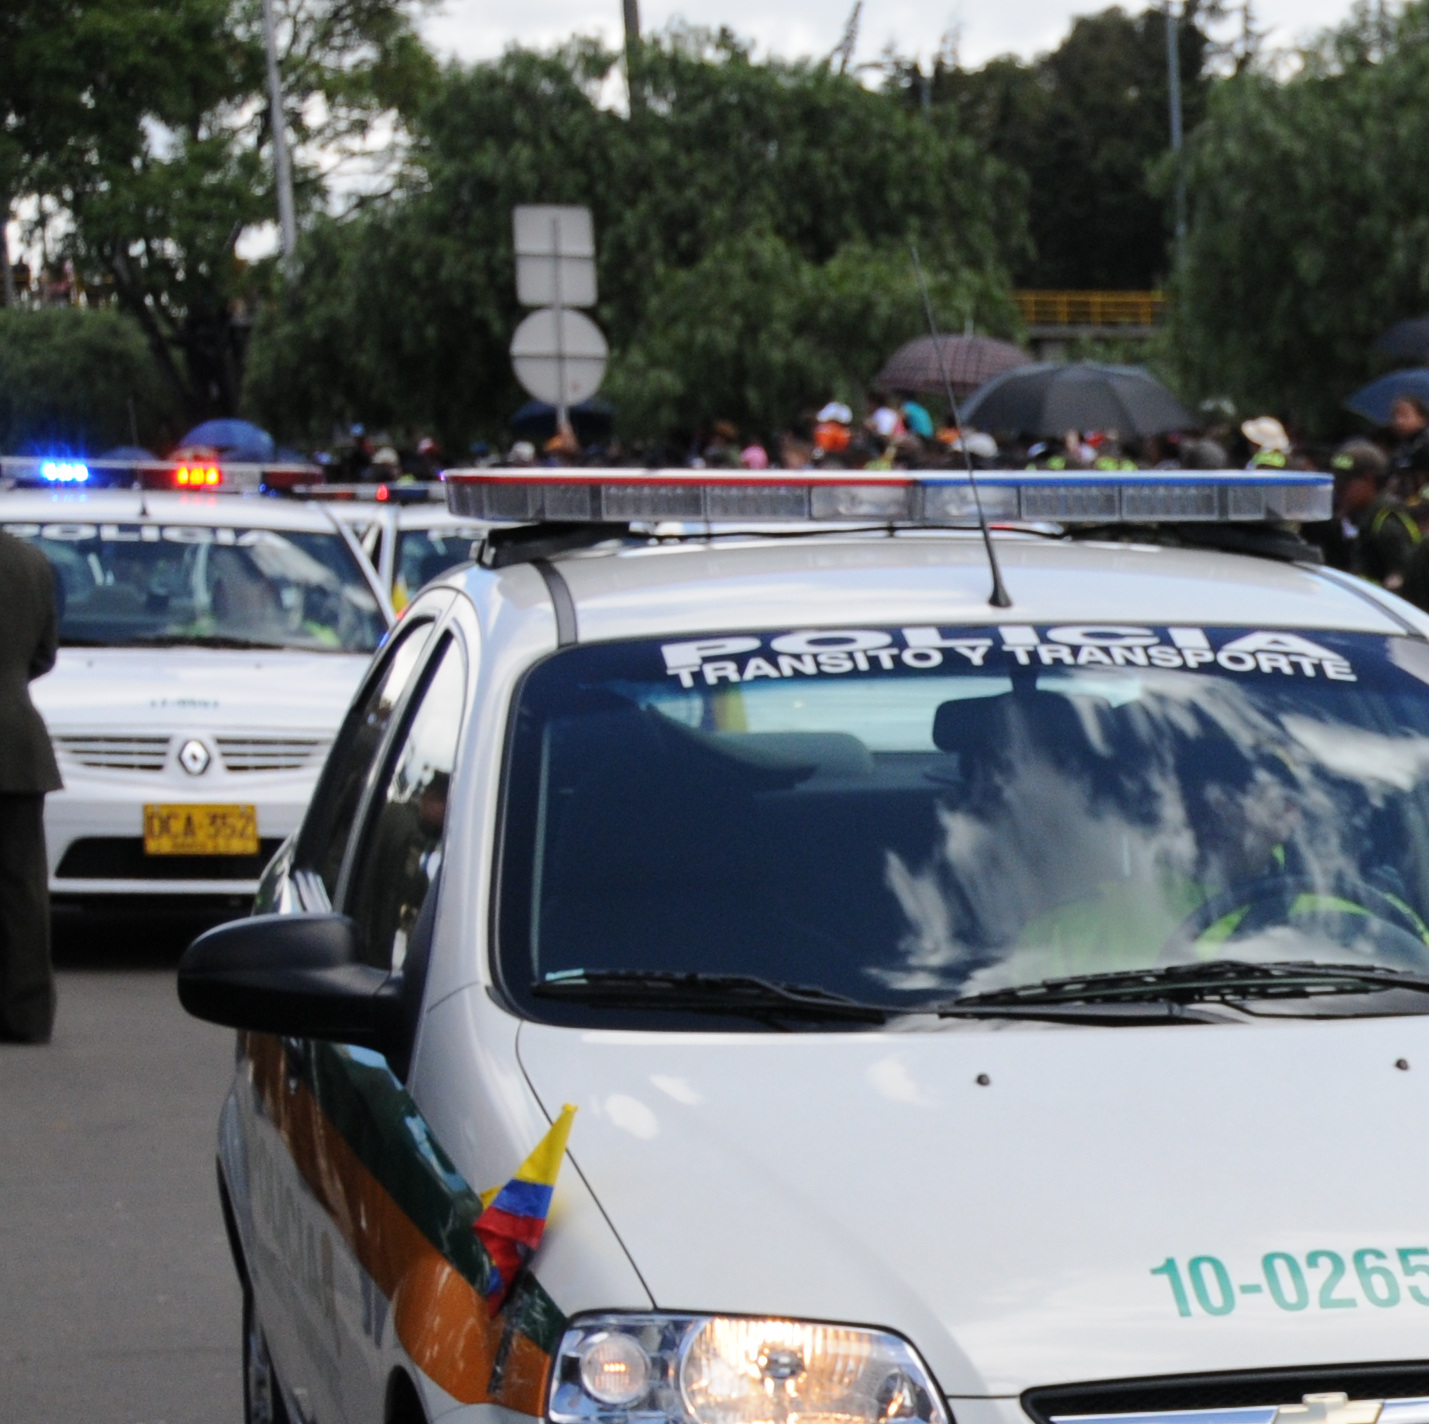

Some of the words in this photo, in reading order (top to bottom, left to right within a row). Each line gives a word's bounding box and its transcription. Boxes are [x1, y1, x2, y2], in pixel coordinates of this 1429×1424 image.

[661, 625, 1346, 668] POLICIA
[666, 647, 943, 688] TRANSITO
[952, 646, 992, 667] Y
[1002, 644, 1358, 682] TRANSPORTE
